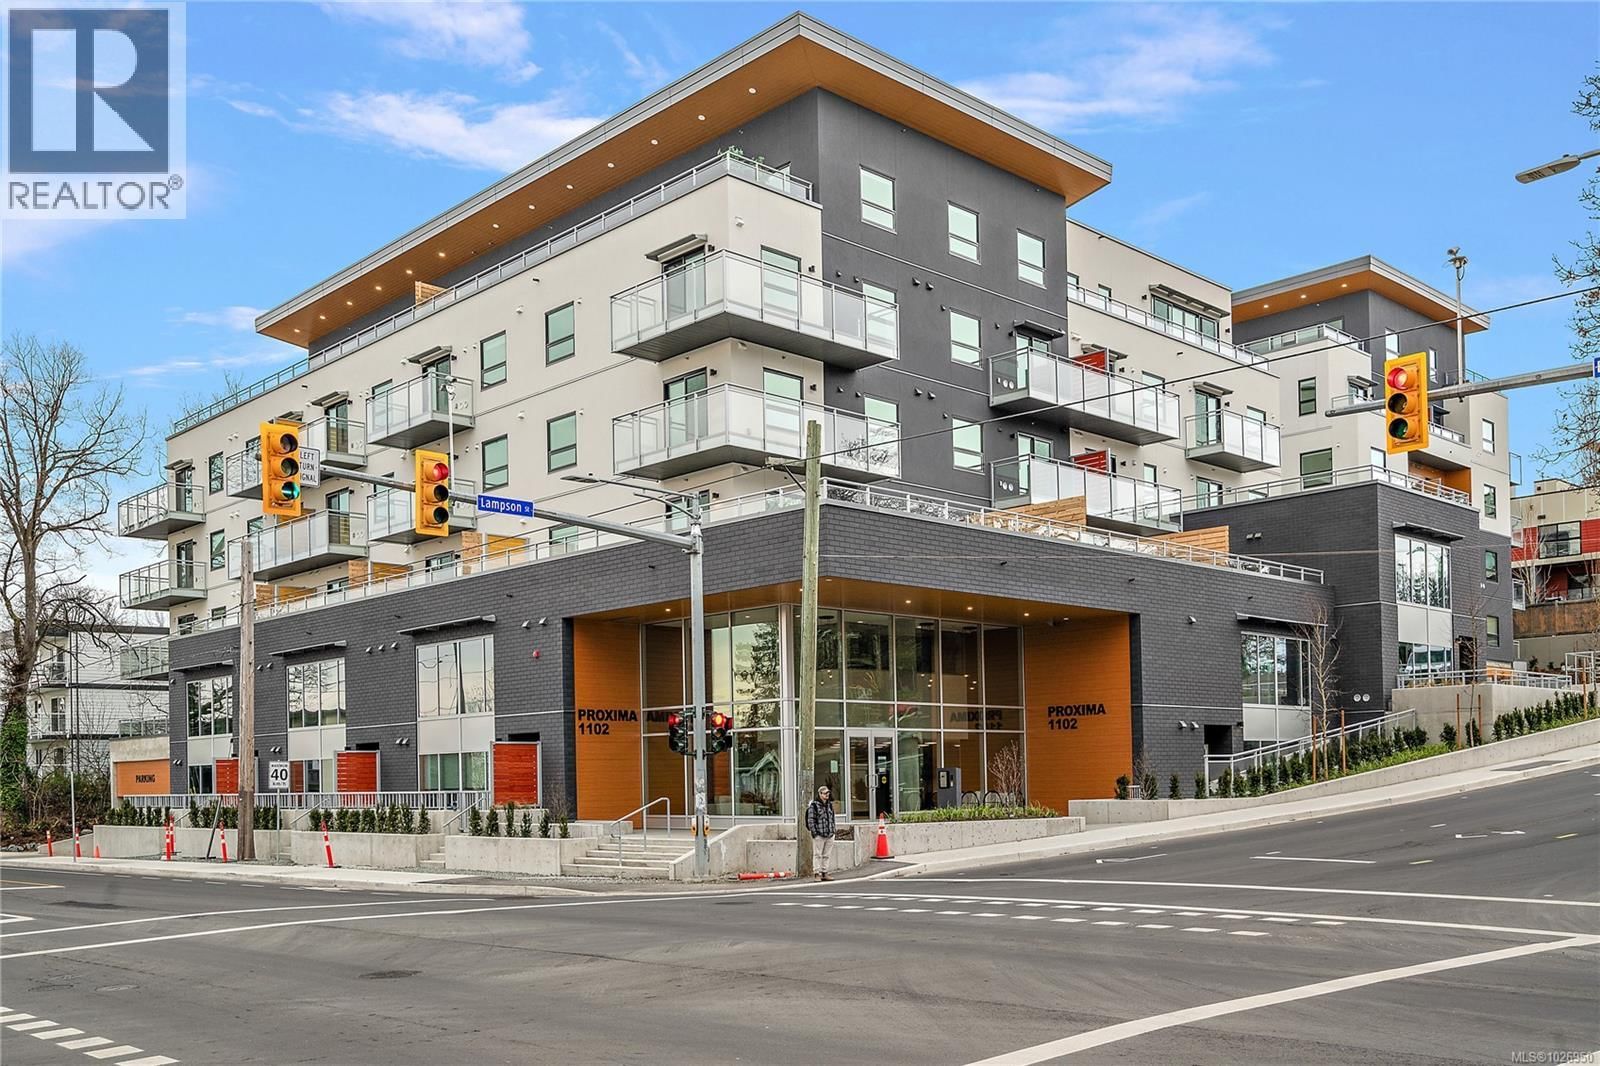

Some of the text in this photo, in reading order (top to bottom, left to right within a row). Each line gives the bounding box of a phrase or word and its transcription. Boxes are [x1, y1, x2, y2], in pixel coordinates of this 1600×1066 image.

[300, 451, 315, 460] LEFT
[299, 461, 315, 471] TURN
[300, 472, 317, 483] IGNAL
[480, 497, 522, 512] Lampson
[578, 709, 638, 722] PROXIMA
[1048, 703, 1106, 717] PROXIMA
[578, 723, 610, 735] 1102
[1048, 718, 1078, 730] 1102
[135, 774, 155, 783] PARKING
[270, 768, 288, 781] 40
